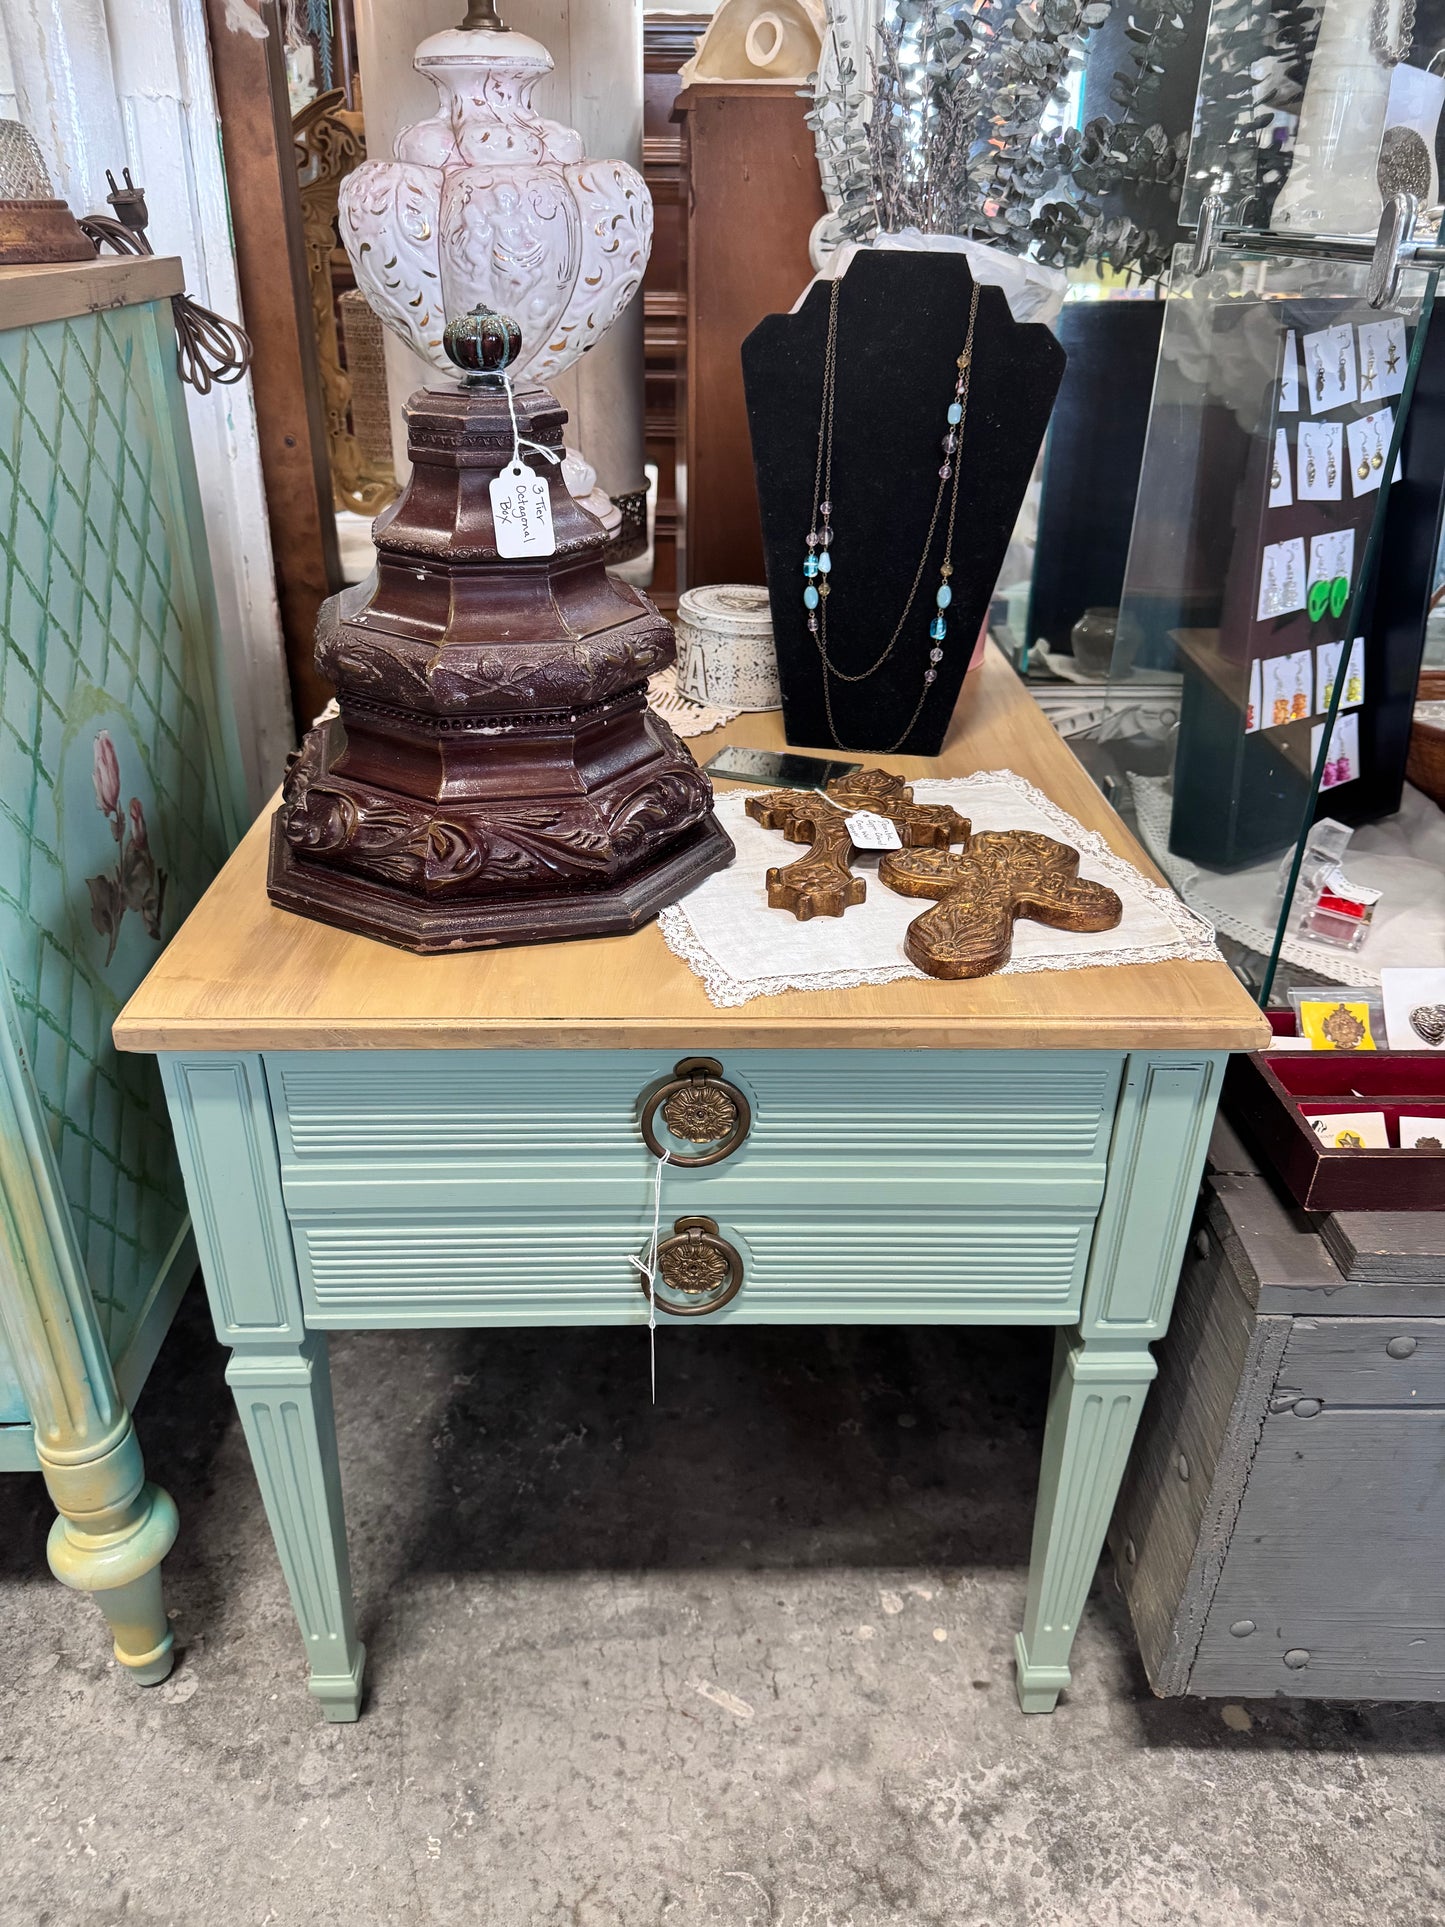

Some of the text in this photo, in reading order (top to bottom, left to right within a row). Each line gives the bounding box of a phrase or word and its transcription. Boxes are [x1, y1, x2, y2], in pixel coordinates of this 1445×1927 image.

[495, 496, 512, 524] Box
[511, 485, 536, 543] Octagonal
[532, 484, 547, 526] 3 Tier
